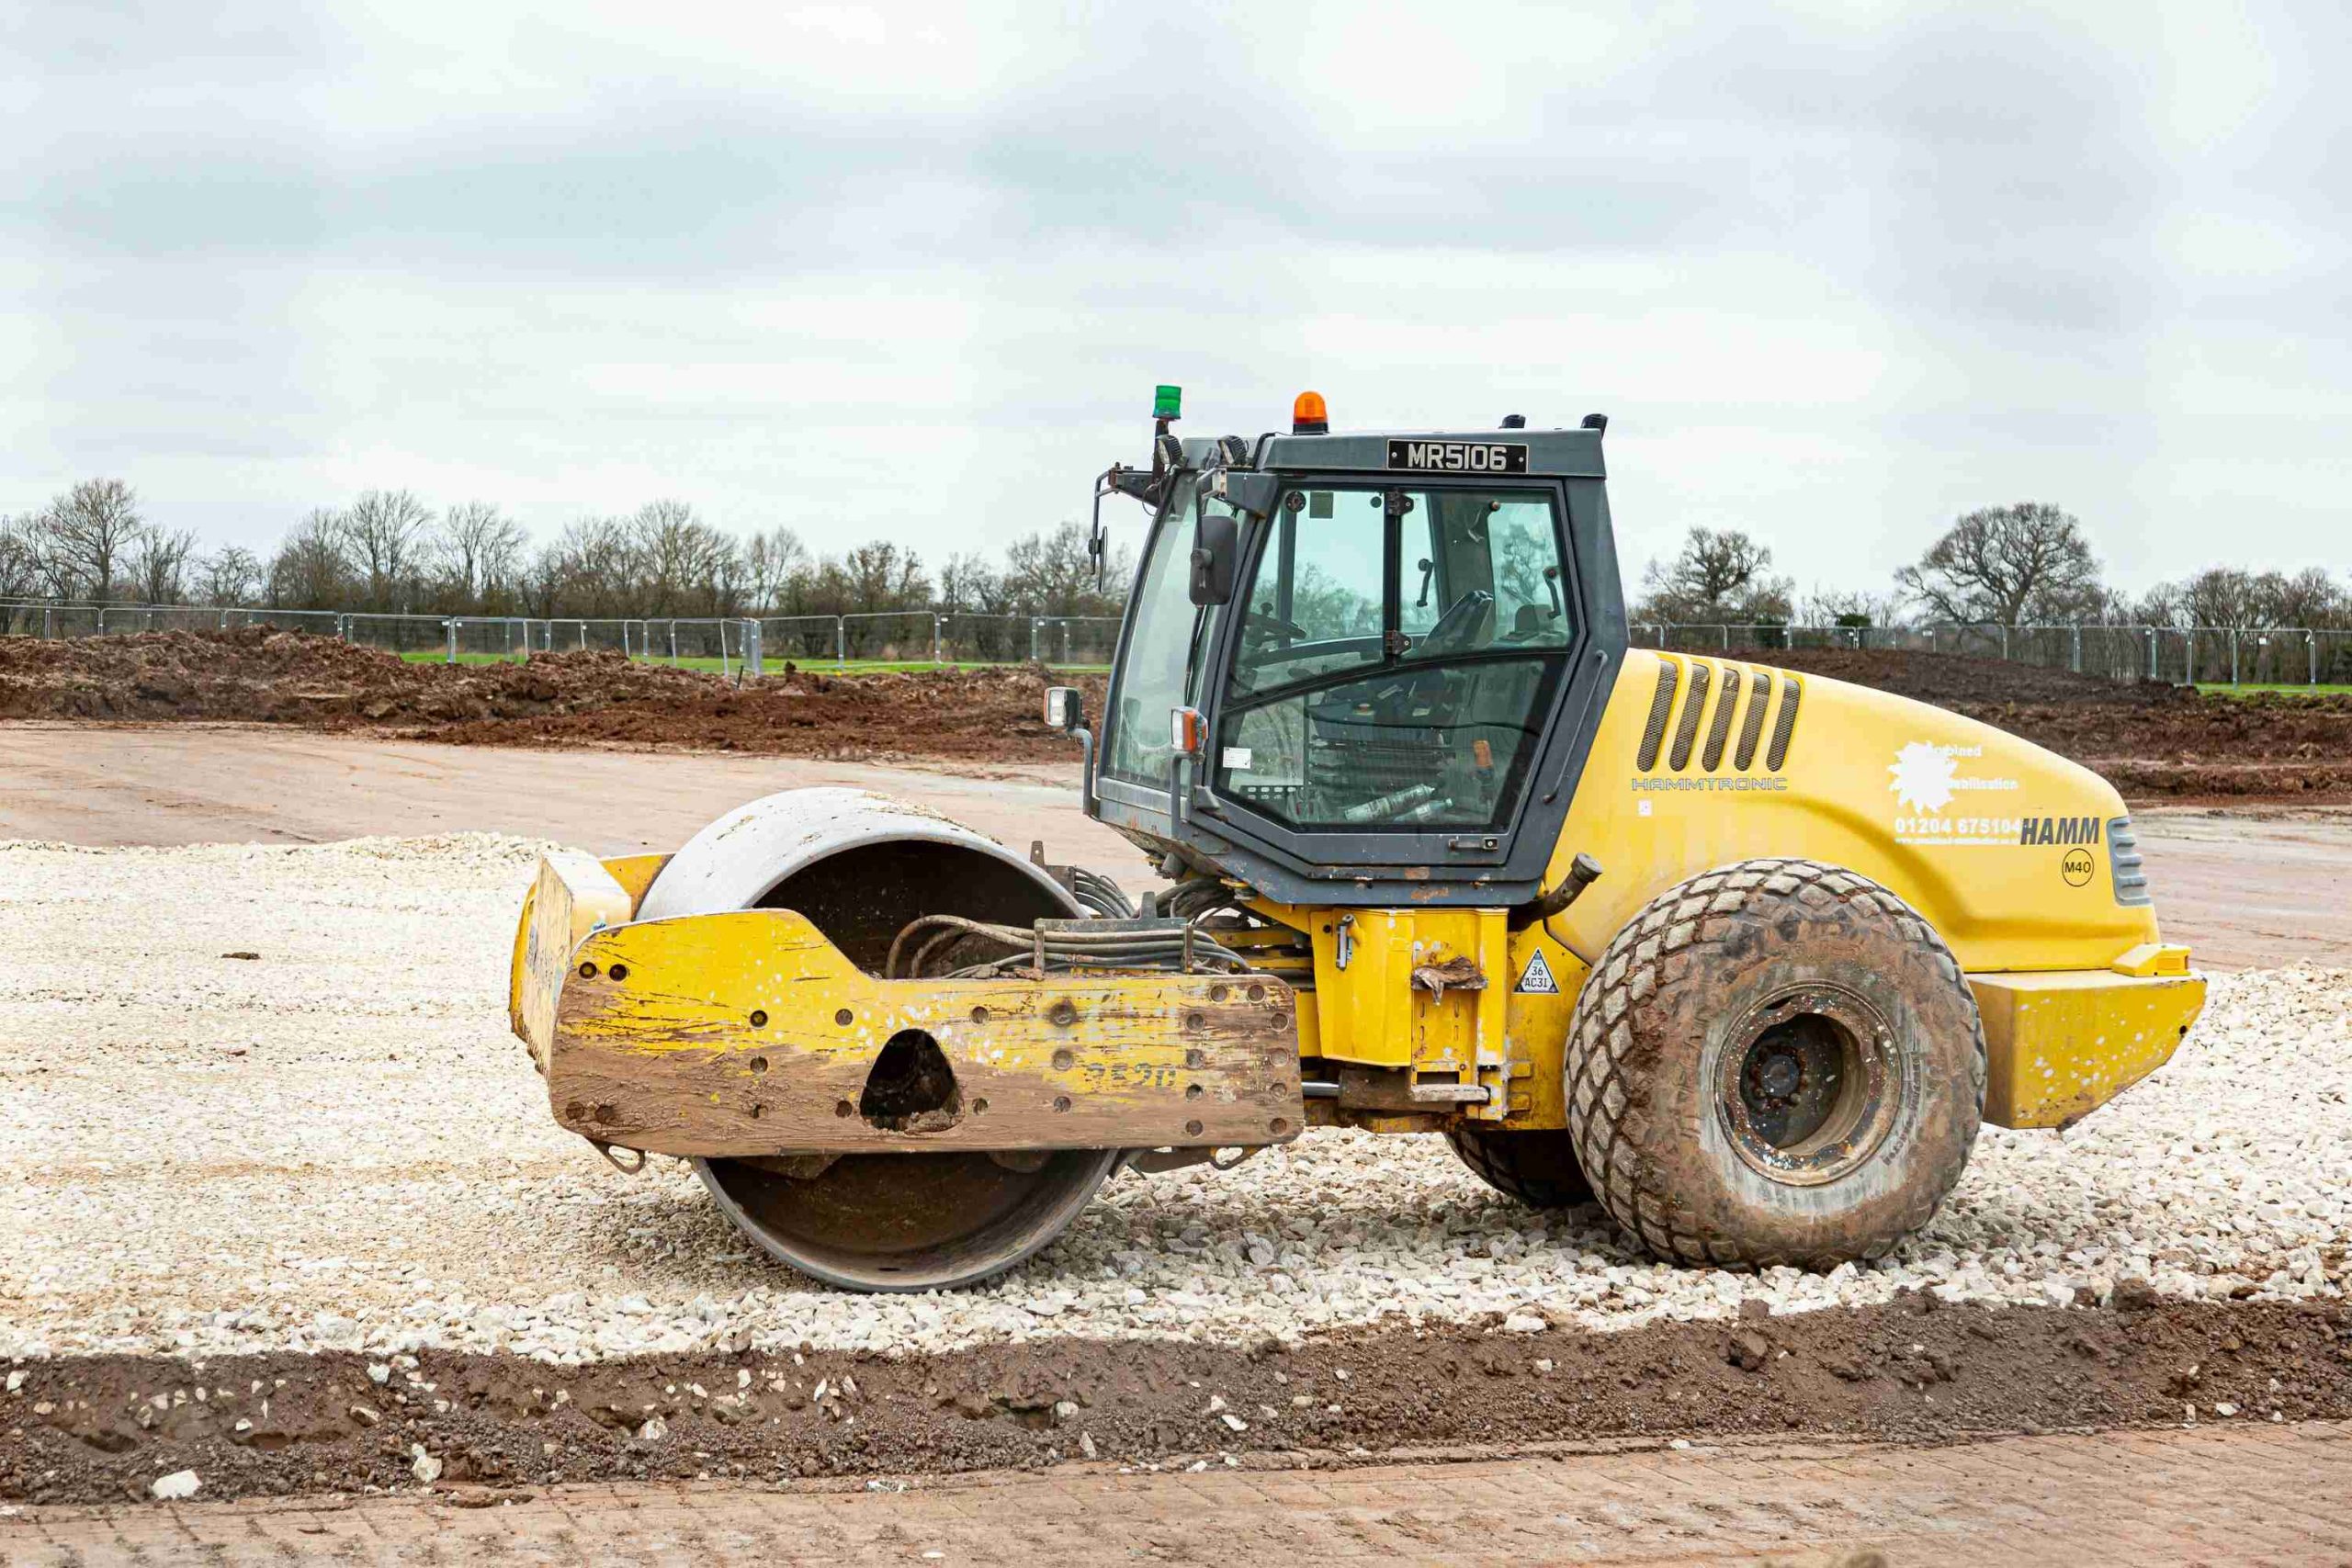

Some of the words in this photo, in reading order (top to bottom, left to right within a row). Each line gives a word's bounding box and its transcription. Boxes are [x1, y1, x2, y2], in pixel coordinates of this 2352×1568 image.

[1632, 777, 1788, 791] HAMMTRONIC
[1894, 818, 1951, 833] 01204
[2020, 817, 2100, 845] HAMM
[2064, 861, 2091, 874] M40
[1532, 966, 1544, 976] 36
